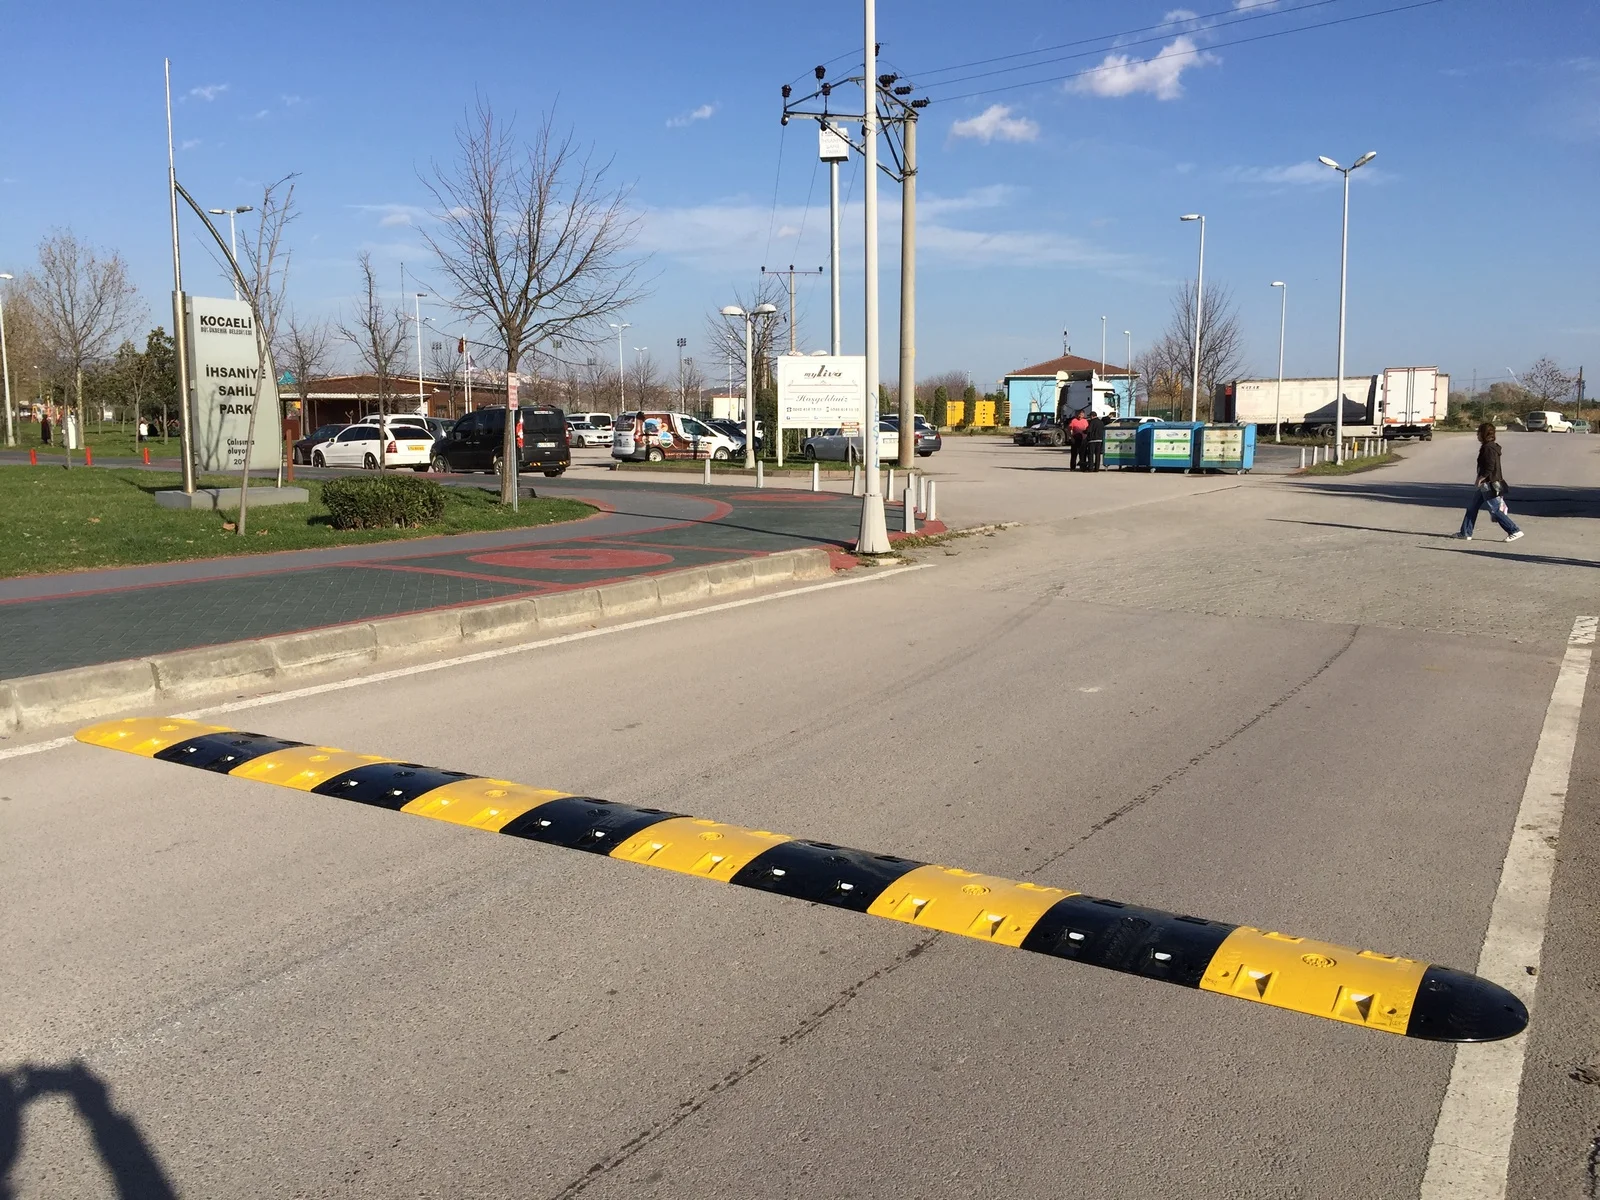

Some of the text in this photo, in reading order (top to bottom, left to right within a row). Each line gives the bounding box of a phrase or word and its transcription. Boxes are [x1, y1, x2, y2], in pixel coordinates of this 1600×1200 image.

[200, 315, 252, 329] KOCAELİ
[206, 364, 266, 379] İHSANİYE
[218, 384, 256, 397] SAHİL
[219, 404, 253, 415] PARK
[226, 438, 255, 447] Çalışına
[227, 447, 248, 456] oluyo
